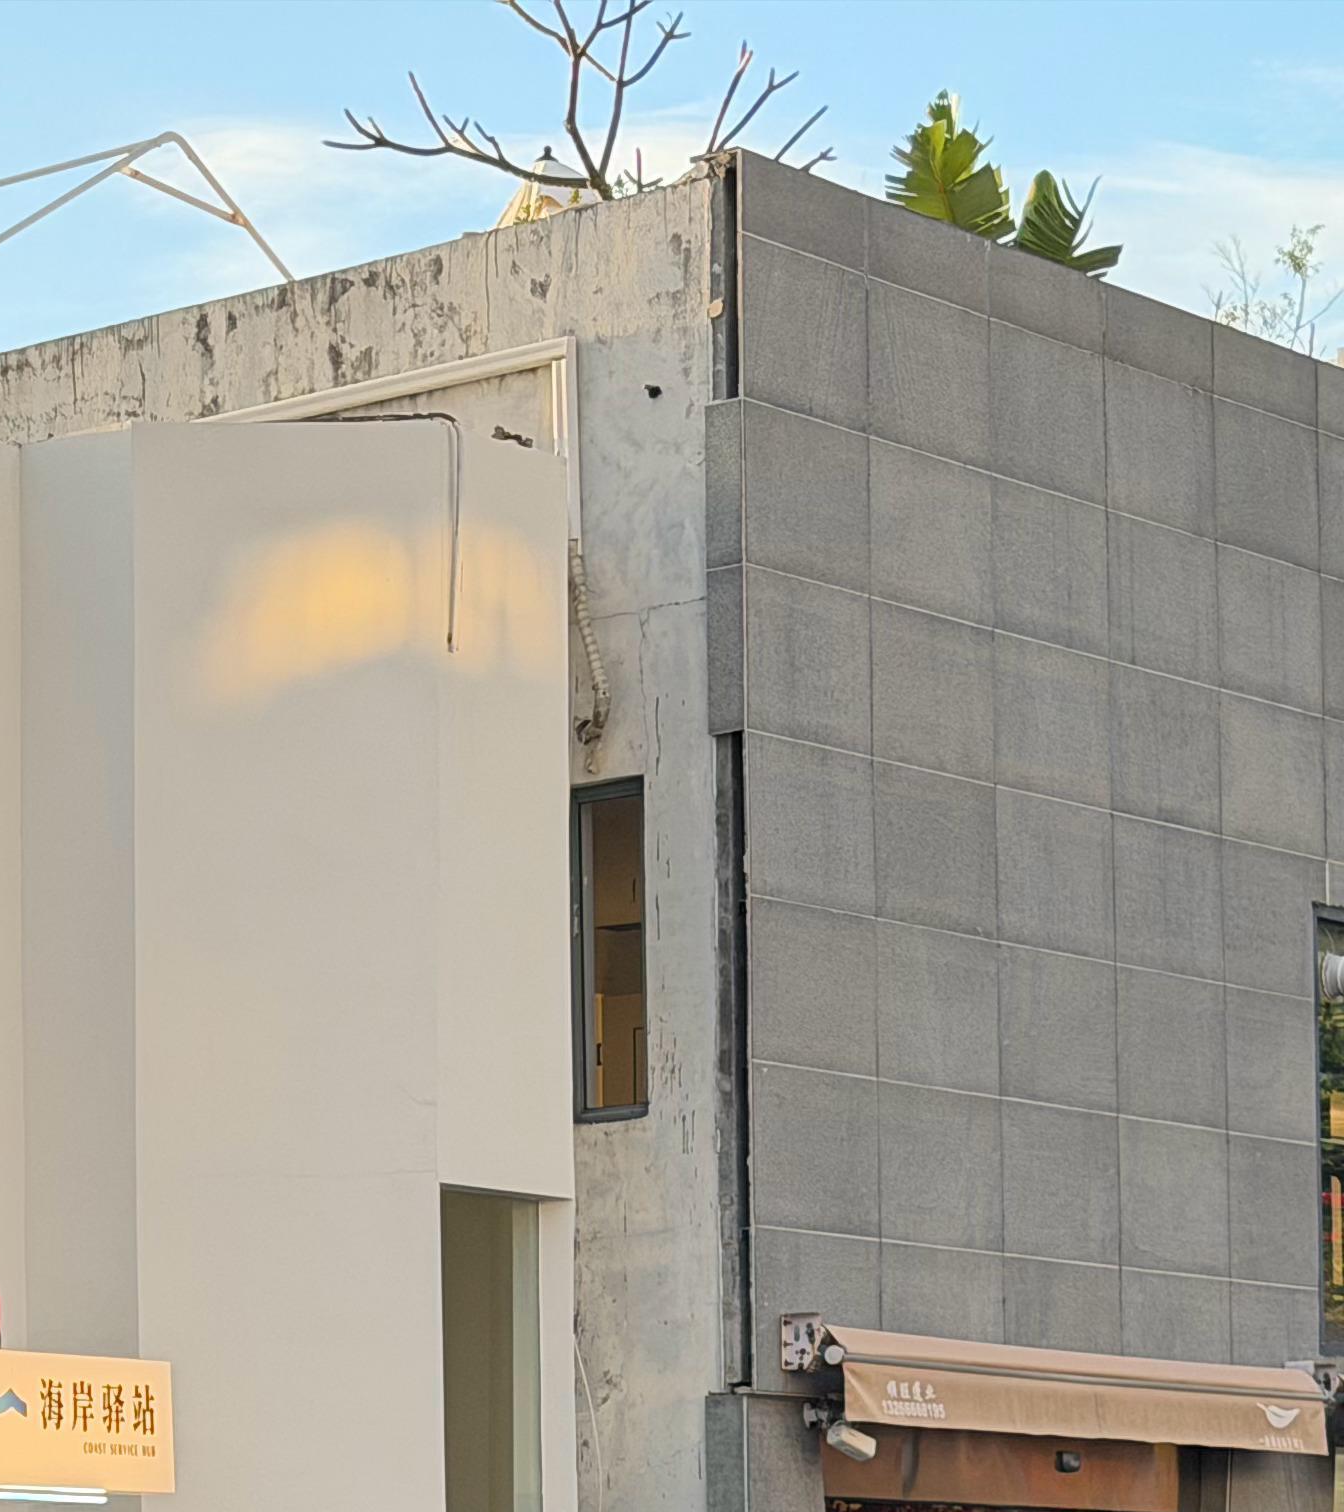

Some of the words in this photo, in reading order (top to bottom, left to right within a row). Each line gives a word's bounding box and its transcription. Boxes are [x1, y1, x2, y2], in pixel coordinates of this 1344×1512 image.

[39, 1378, 156, 1435] 海岸驿站
[83, 1441, 106, 1455] COAST
[110, 1443, 138, 1457] SERVICE
